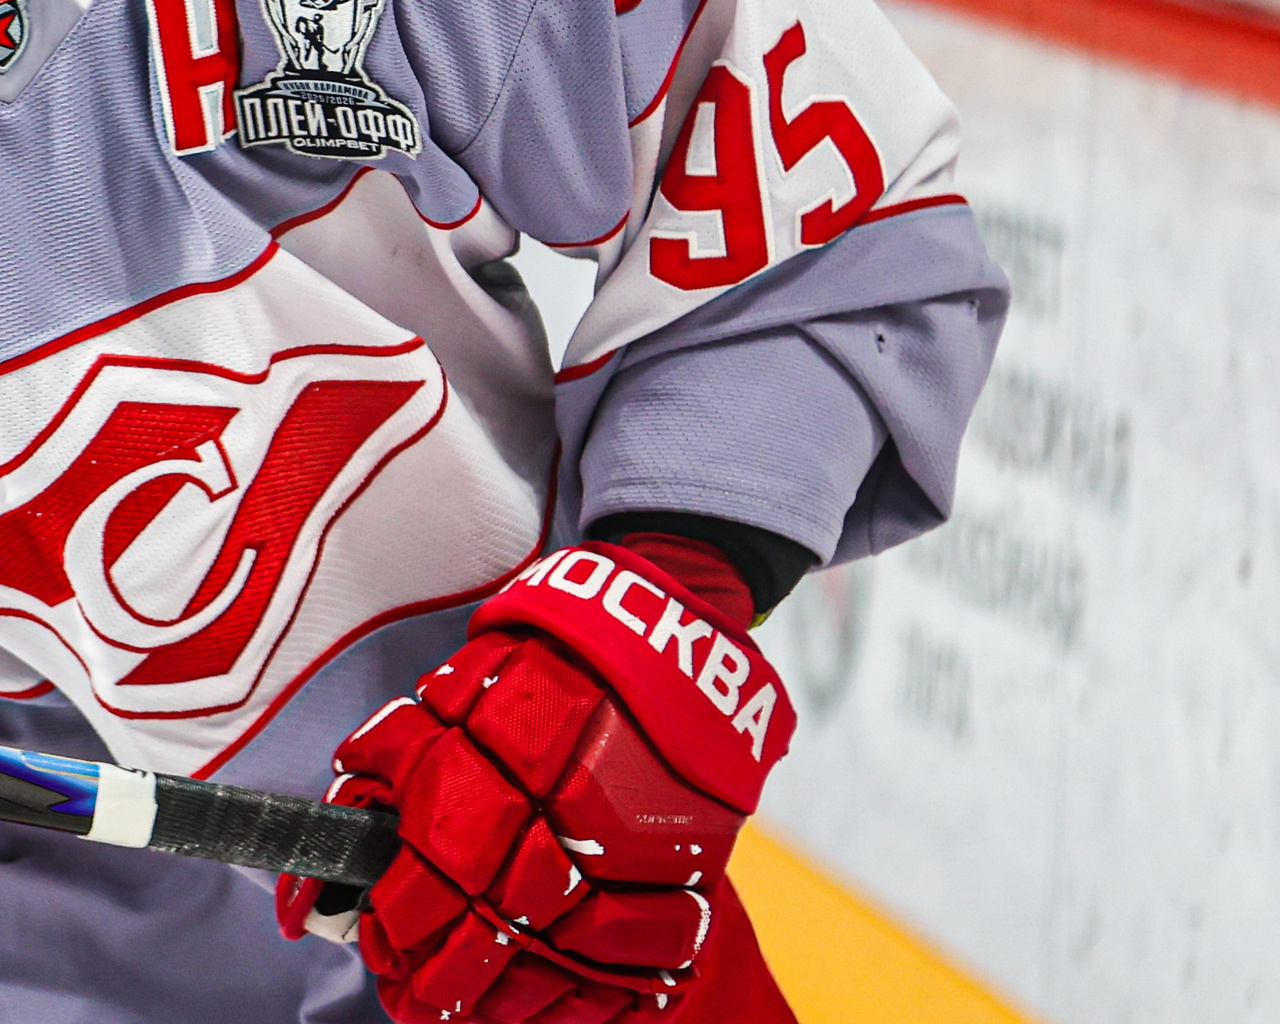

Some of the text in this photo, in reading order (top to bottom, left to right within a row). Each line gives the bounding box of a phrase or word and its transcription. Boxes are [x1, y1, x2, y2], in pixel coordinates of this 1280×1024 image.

[243, 97, 415, 151] ПЛЕЙ-ОФФ
[292, 137, 381, 152] OLIMPBET
[648, 18, 887, 291] 95
